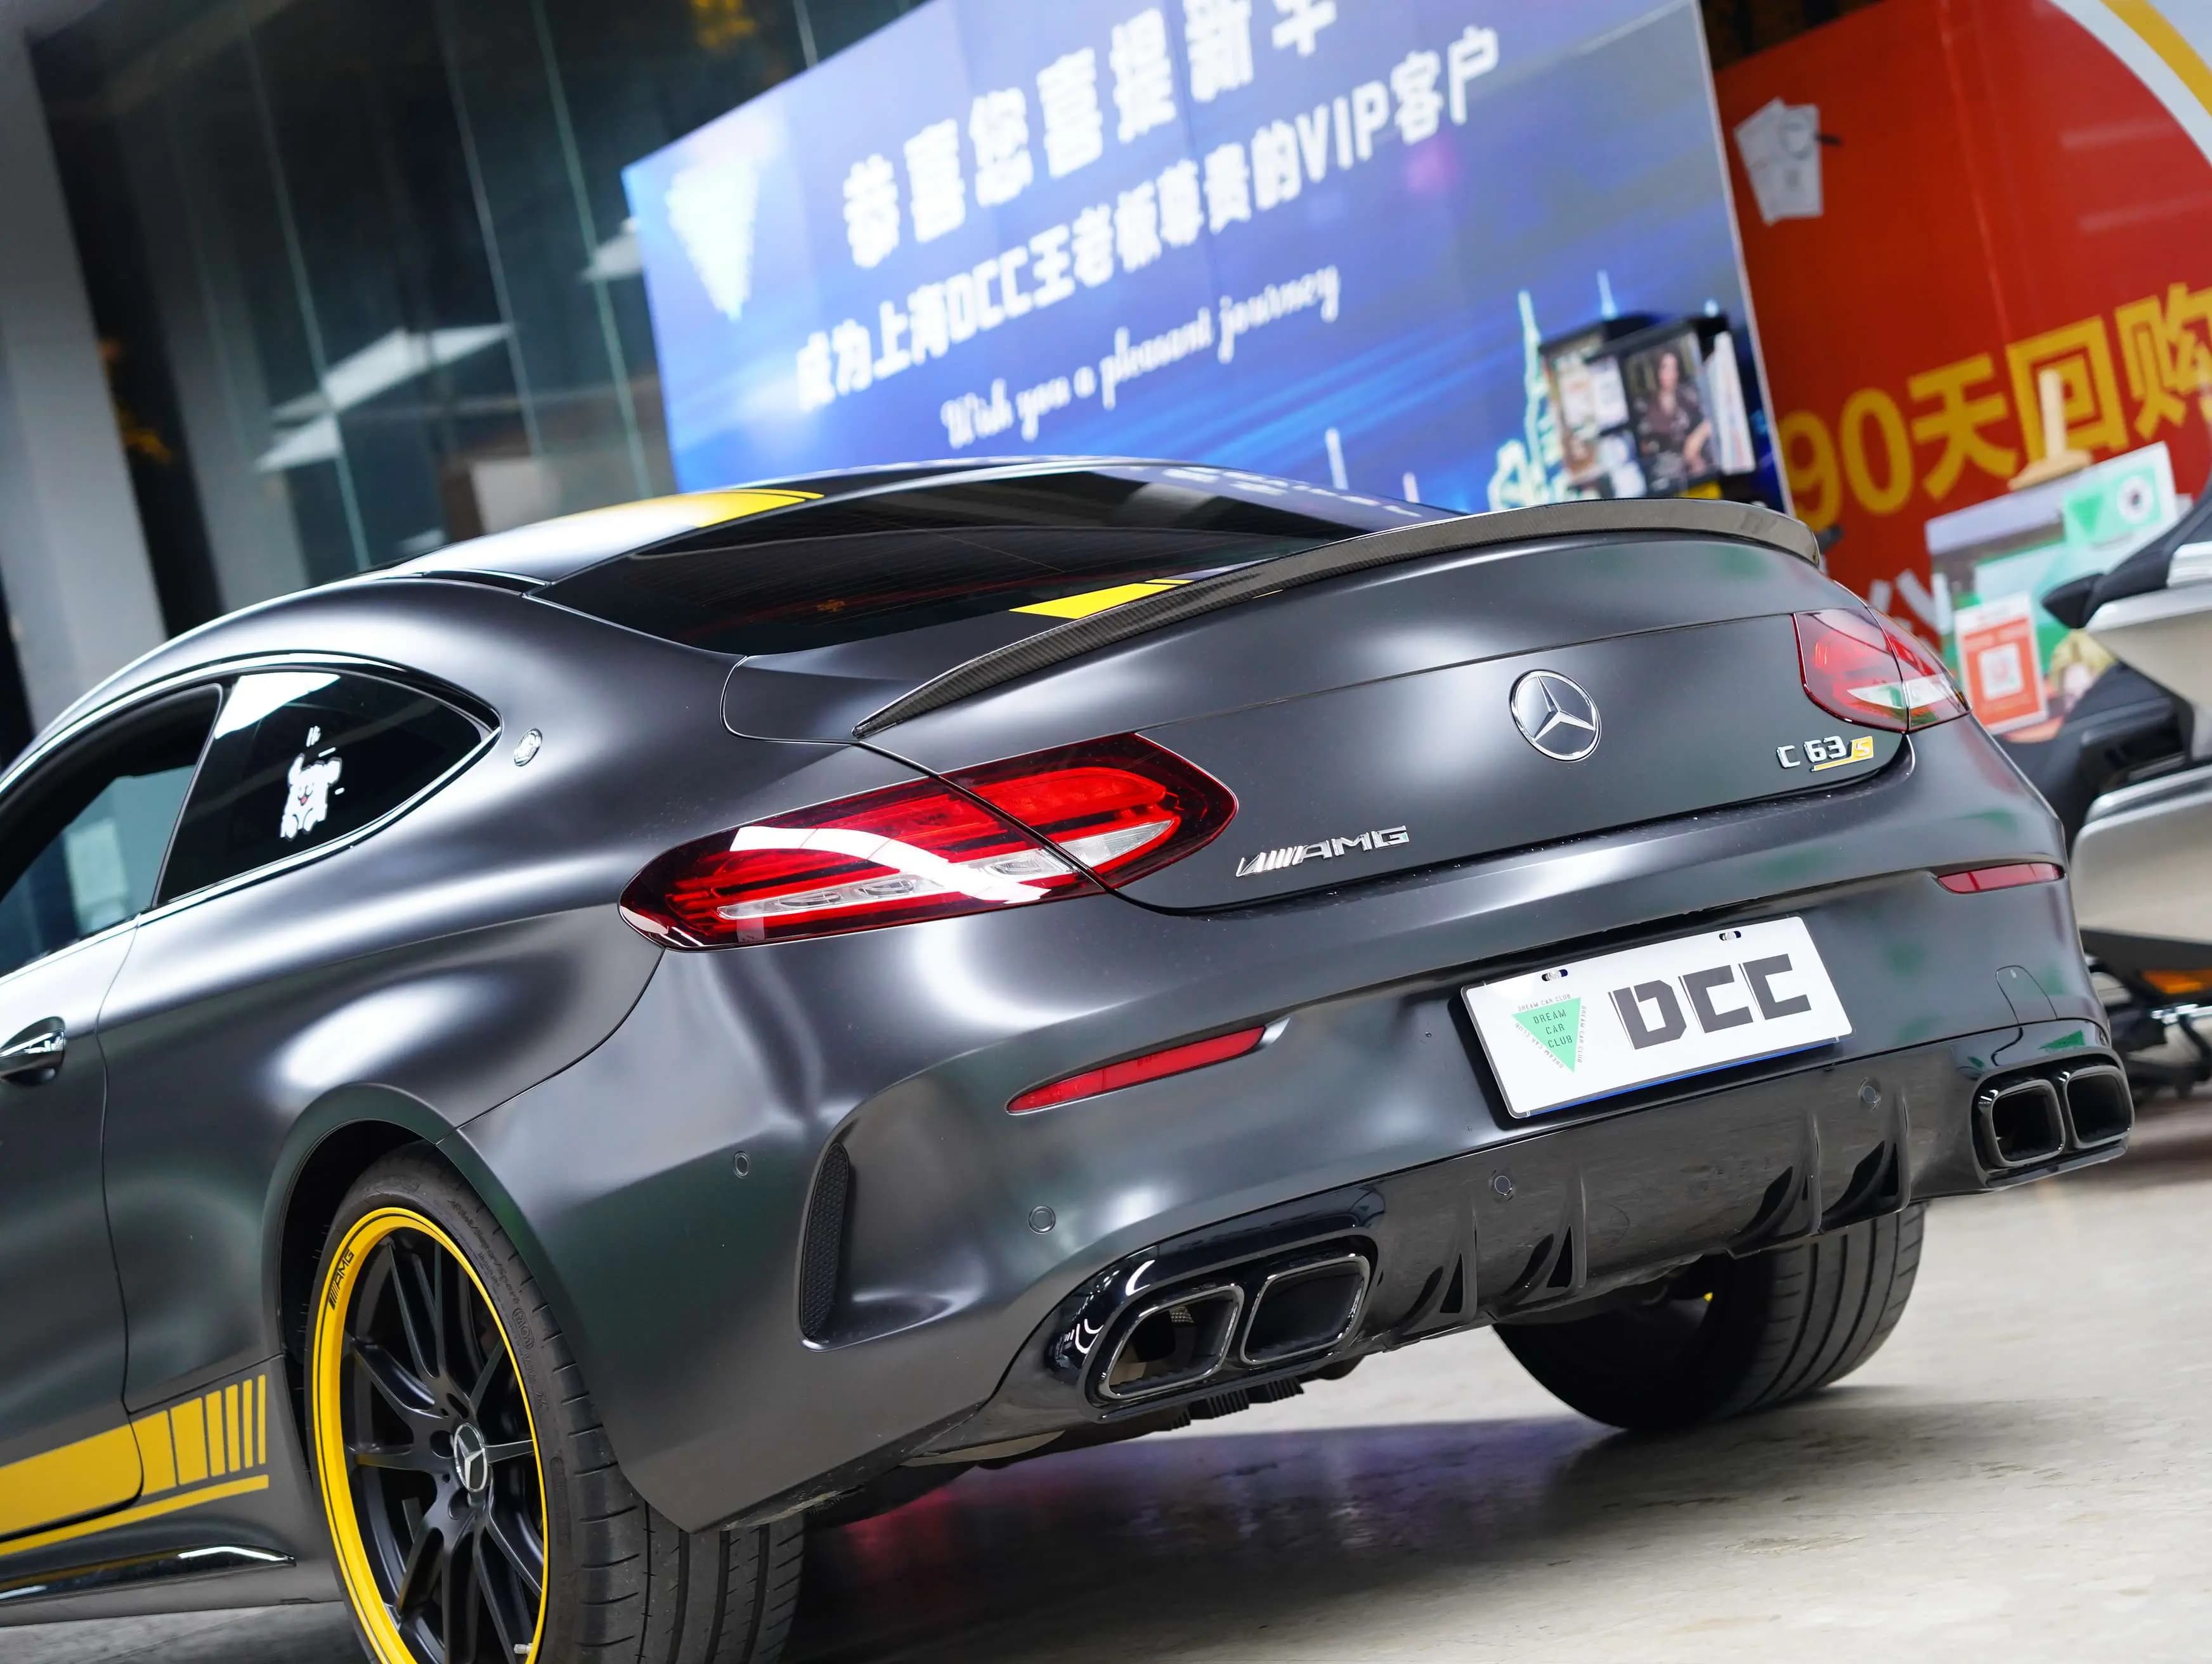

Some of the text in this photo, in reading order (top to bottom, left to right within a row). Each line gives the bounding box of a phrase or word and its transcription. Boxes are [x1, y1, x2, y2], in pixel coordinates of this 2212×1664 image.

[1017, 377, 1071, 441] you
[1074, 366, 1096, 398] a
[1100, 307, 1214, 410] pleasant
[1218, 265, 1339, 363] journey
[1776, 744, 1800, 768] C
[1518, 1002, 1539, 1011] DREAM
[1555, 994, 1571, 1002] CLUB
[1608, 954, 1812, 1050] DCC
[1533, 1009, 1566, 1024] DREAM
[1545, 1024, 1565, 1034] CAR
[1547, 1035, 1573, 1048] CLUB
